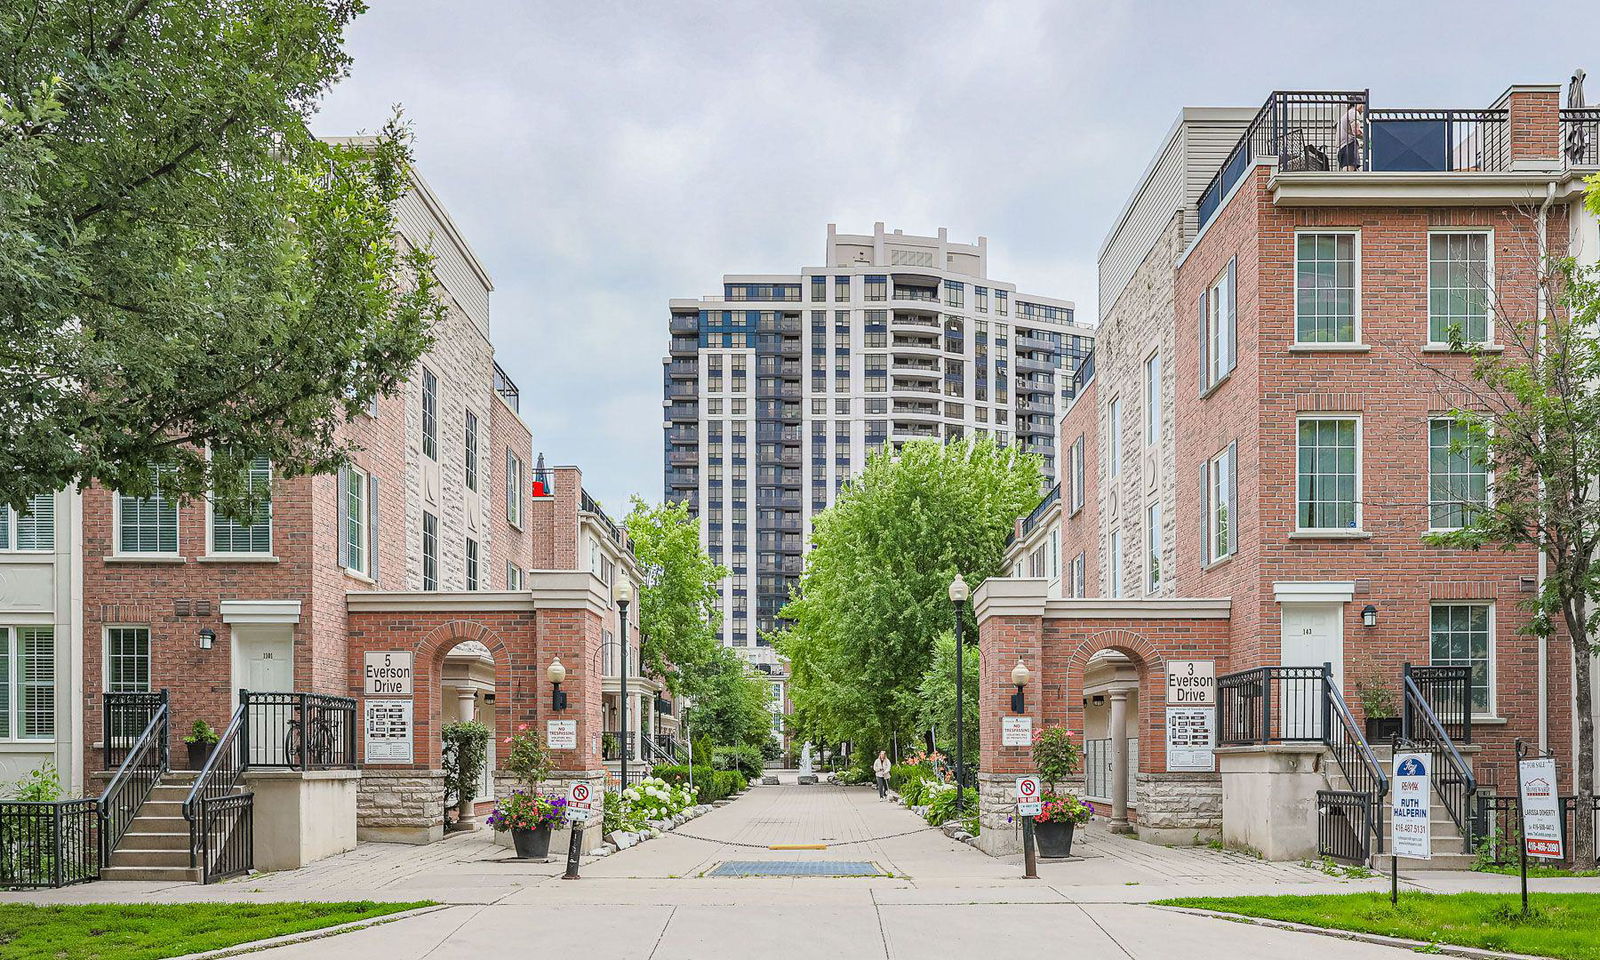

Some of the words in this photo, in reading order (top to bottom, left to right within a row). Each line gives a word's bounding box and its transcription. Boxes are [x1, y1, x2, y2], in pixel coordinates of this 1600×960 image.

[385, 654, 391, 667] 5
[366, 665, 410, 678] Everson
[1188, 663, 1194, 676] 3
[374, 680, 402, 692] Drive
[1170, 674, 1212, 687] Everson
[1178, 688, 1205, 701] Drive
[1401, 798, 1419, 807] RUTH
[1394, 808, 1426, 818] HALPERIN
